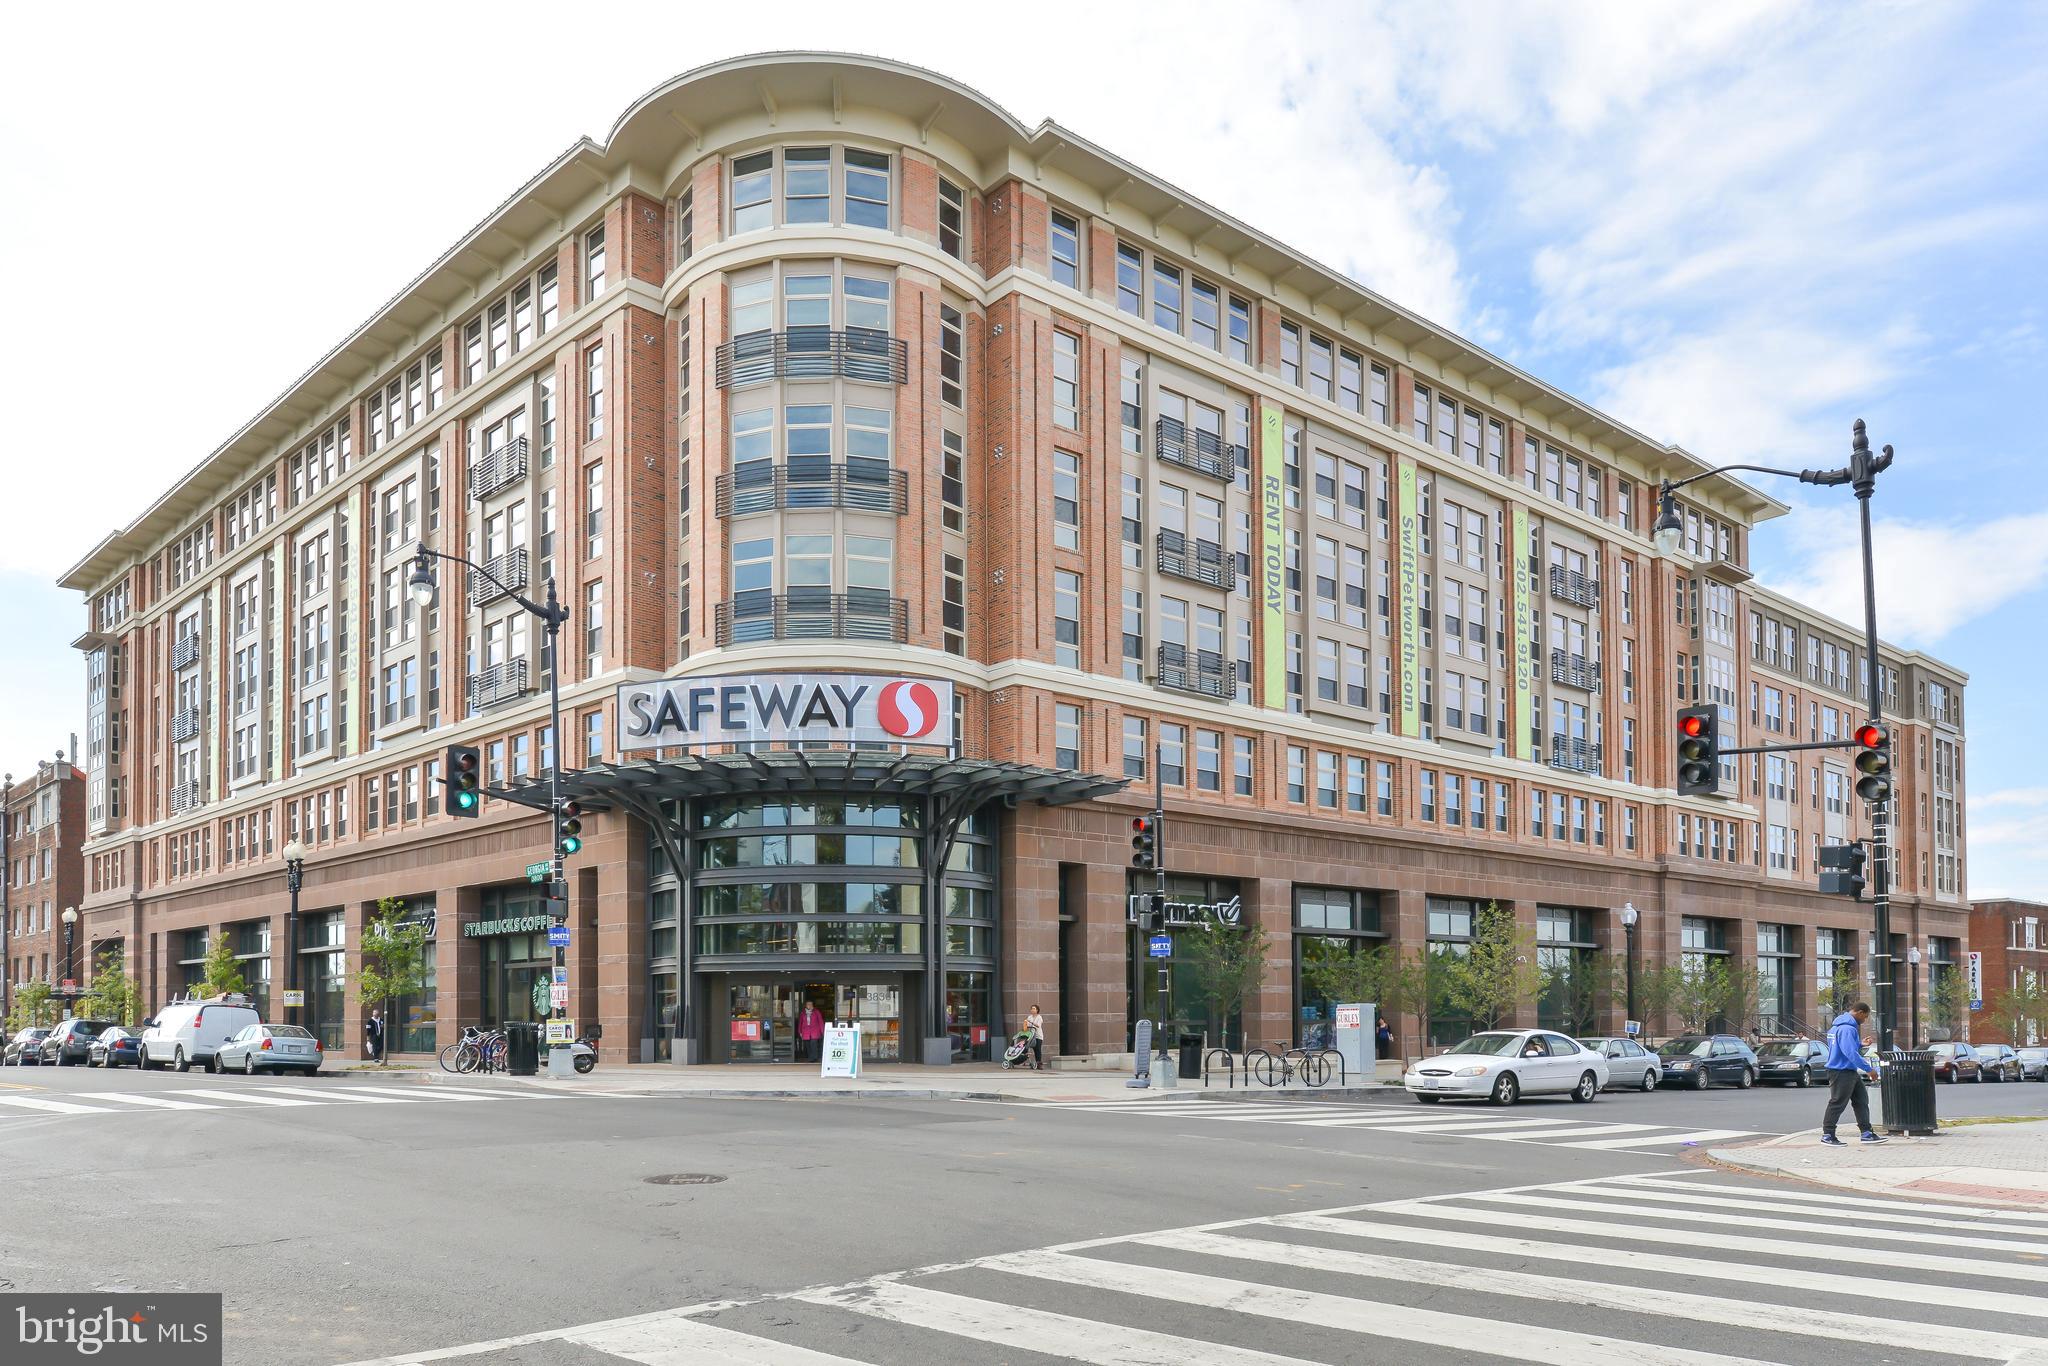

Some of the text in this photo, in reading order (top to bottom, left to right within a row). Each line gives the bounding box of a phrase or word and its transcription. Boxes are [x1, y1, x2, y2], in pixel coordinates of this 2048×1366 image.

[1266, 475, 1281, 615] RENT TODAY
[1402, 515, 1416, 712] SwiftPetworth.com
[1516, 559, 1528, 690] 202.541.9120
[627, 682, 871, 737] SAFEWAY
[464, 914, 556, 937] STARBUCKS COFFE
[1336, 1013, 1359, 1023] GURLEY
[832, 1050, 842, 1058] 10
